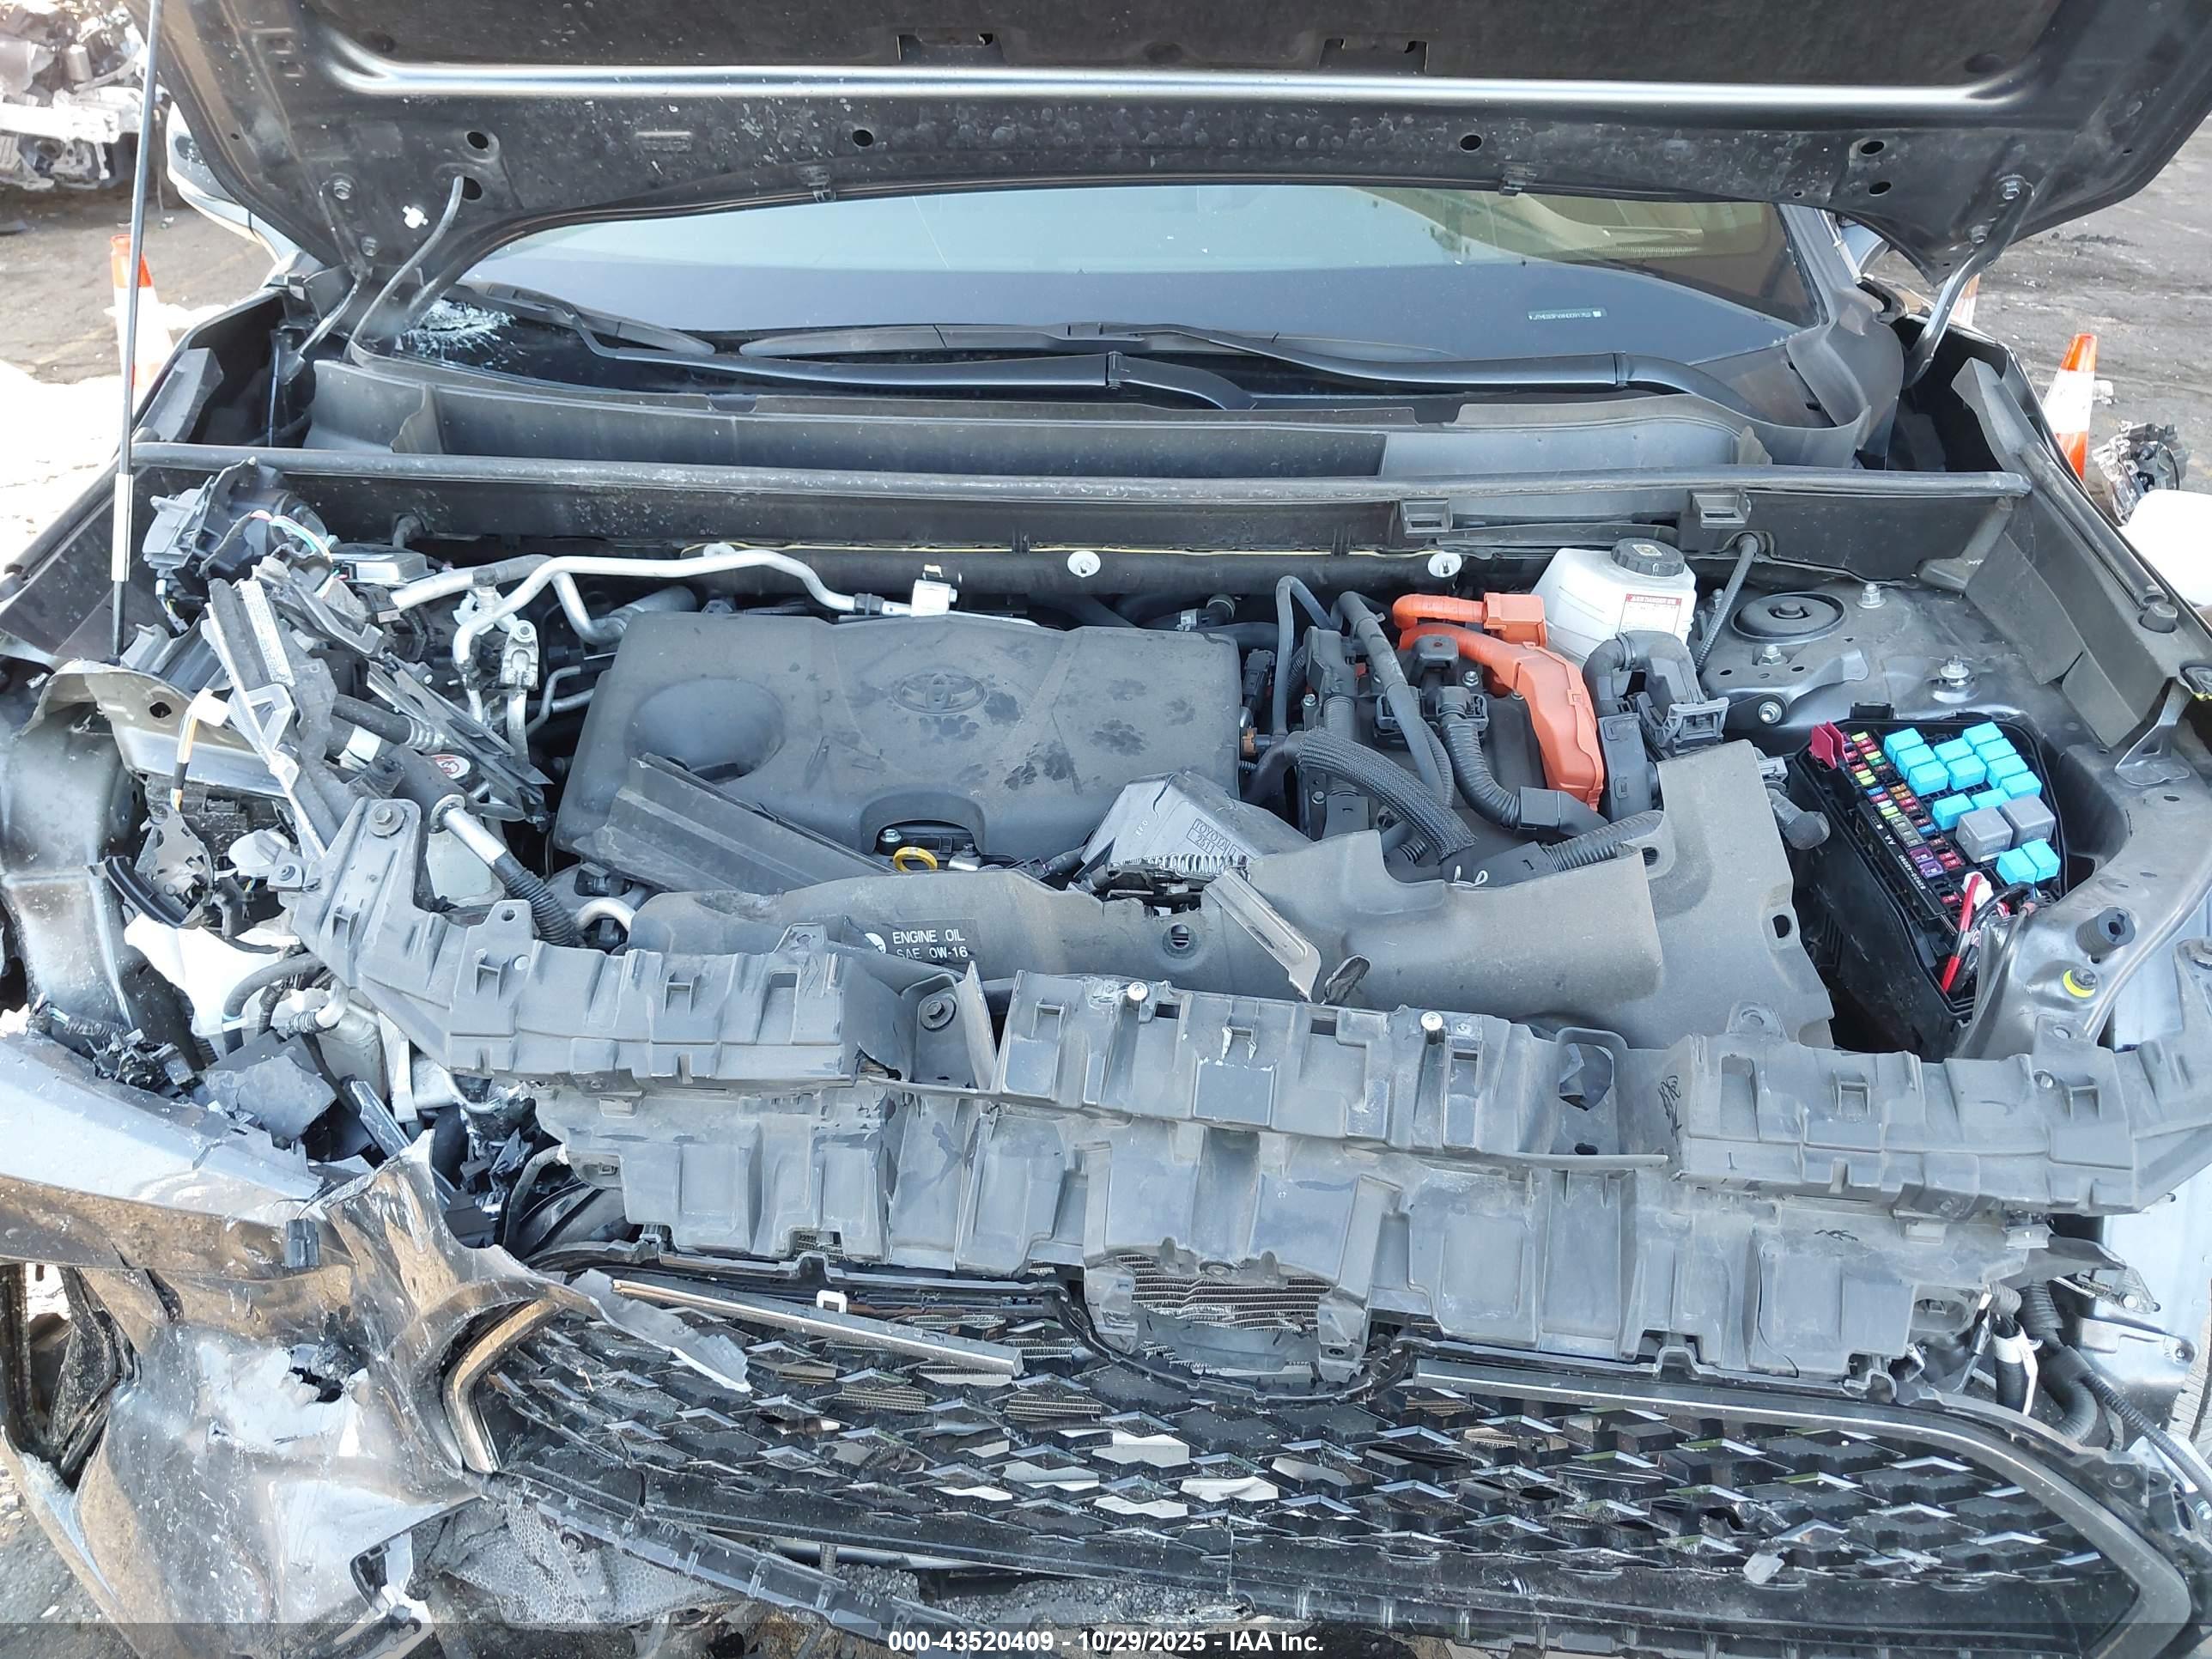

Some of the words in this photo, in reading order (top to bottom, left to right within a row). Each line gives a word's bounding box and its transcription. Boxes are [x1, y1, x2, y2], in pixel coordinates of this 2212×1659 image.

[892, 930, 938, 944] ENGINE
[945, 929, 966, 942] OIL
[896, 947, 922, 960] SAE
